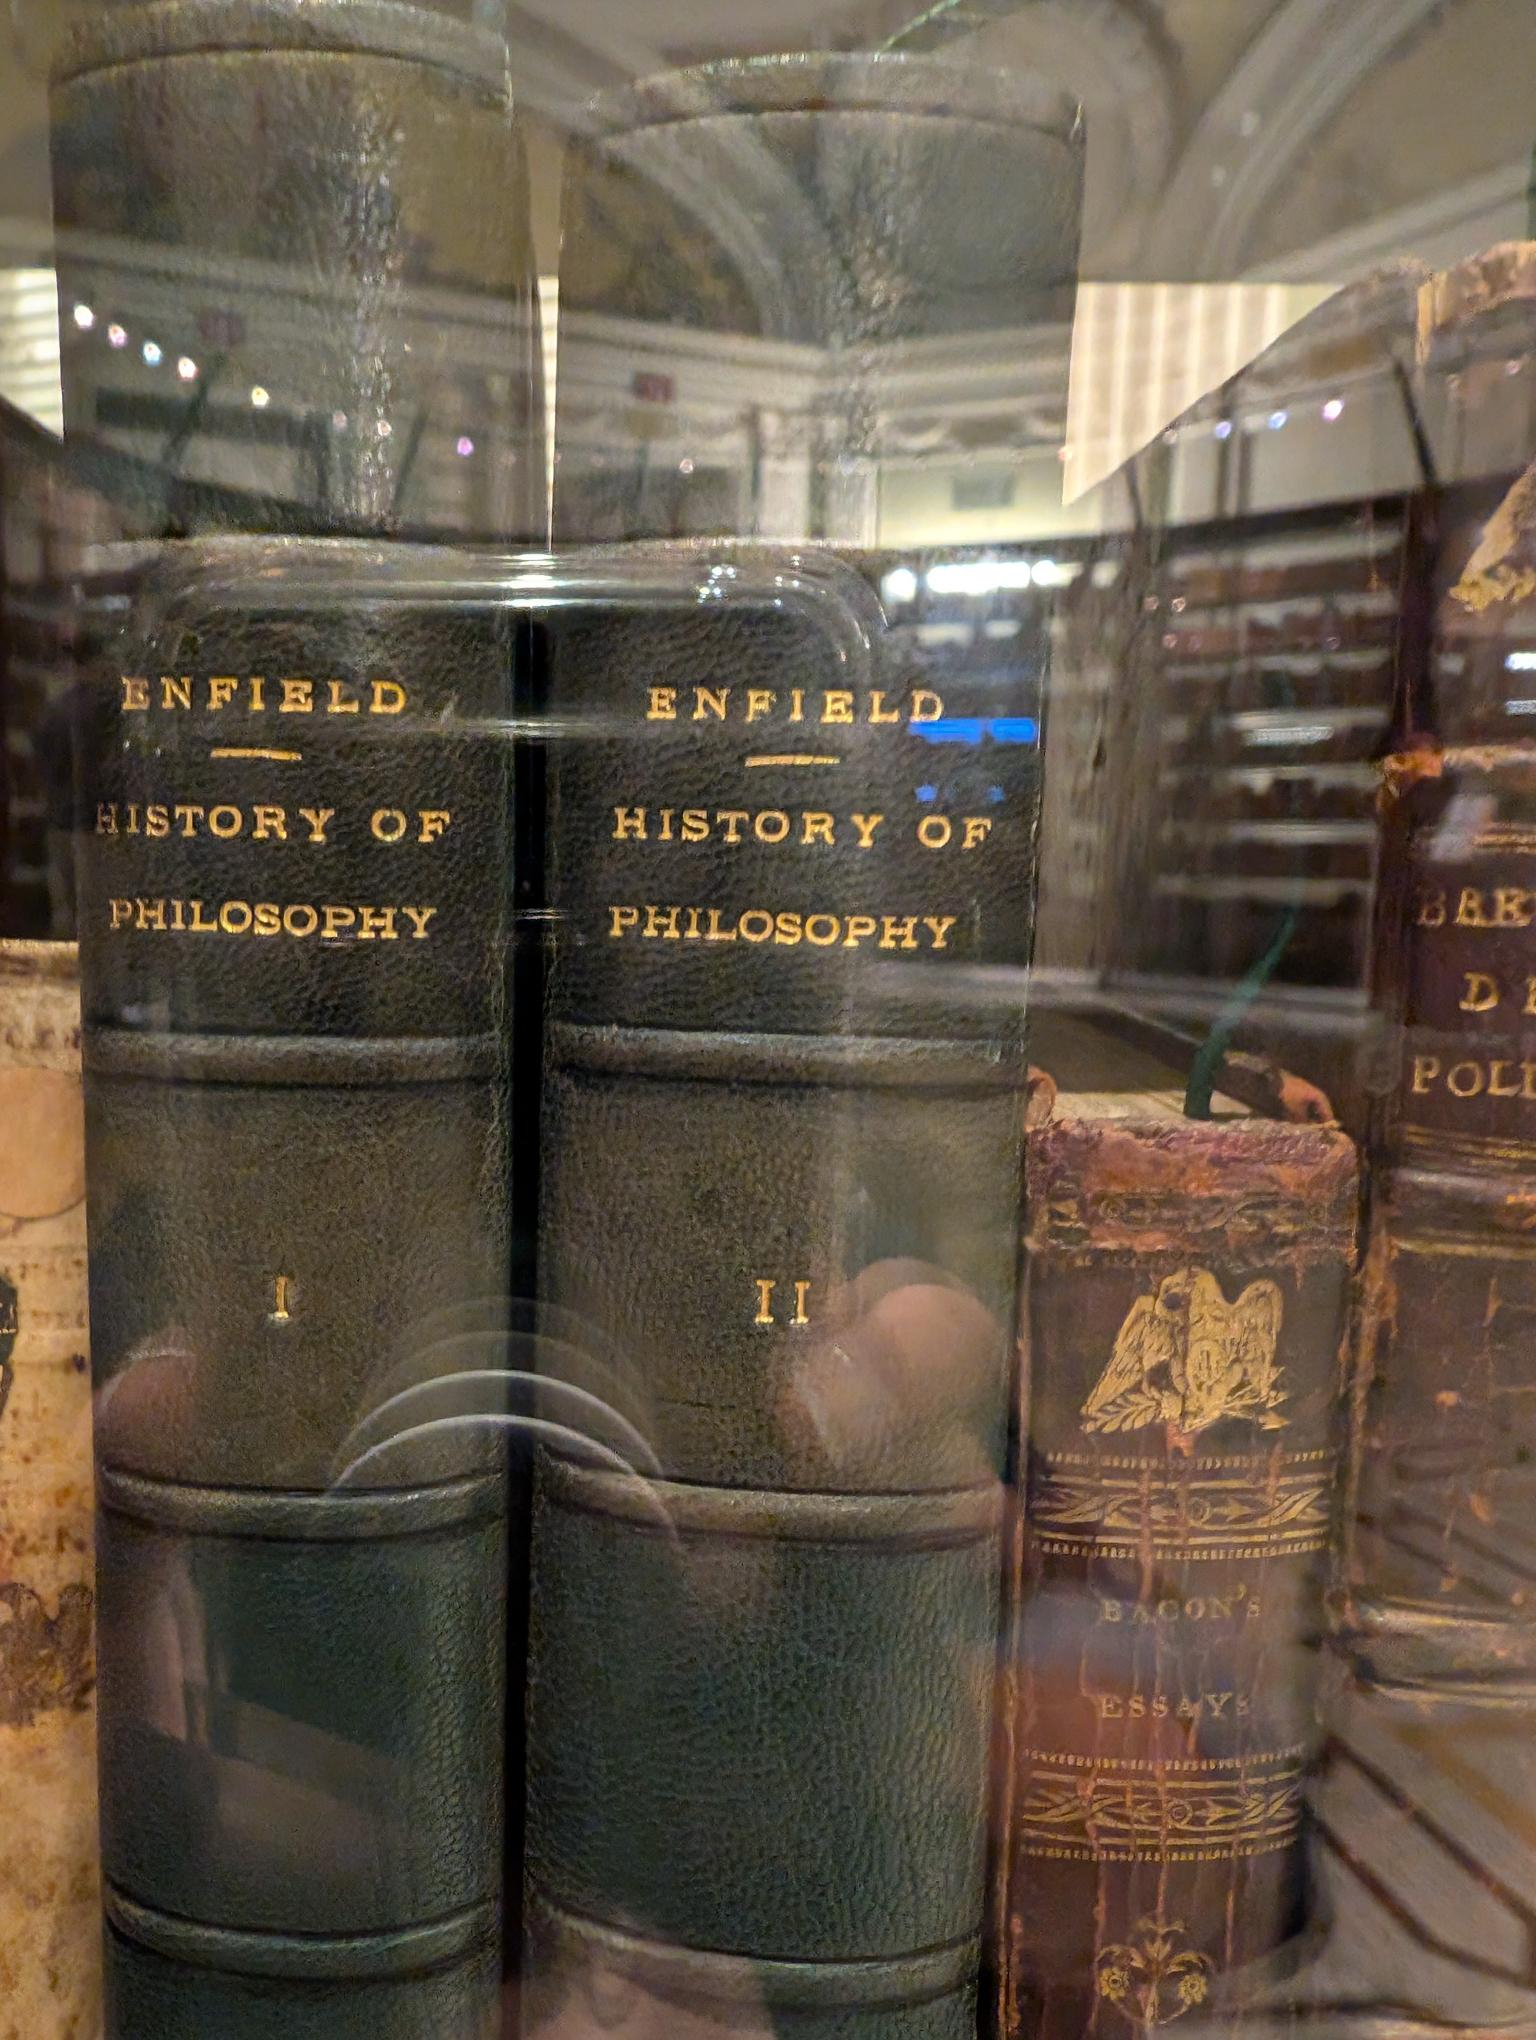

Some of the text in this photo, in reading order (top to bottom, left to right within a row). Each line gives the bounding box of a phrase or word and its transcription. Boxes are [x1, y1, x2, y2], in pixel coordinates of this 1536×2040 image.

[121, 676, 408, 714] ENFIELD
[646, 687, 943, 724] ENFIELD
[96, 803, 451, 843] HISTORY OF
[612, 806, 993, 849] HISTORY OF
[110, 899, 436, 940] PHILOSOPHY
[1417, 886, 1536, 927] BAR
[609, 905, 956, 950] PHILOSOPHY
[269, 1275, 290, 1319] I
[753, 1279, 811, 1324] II
